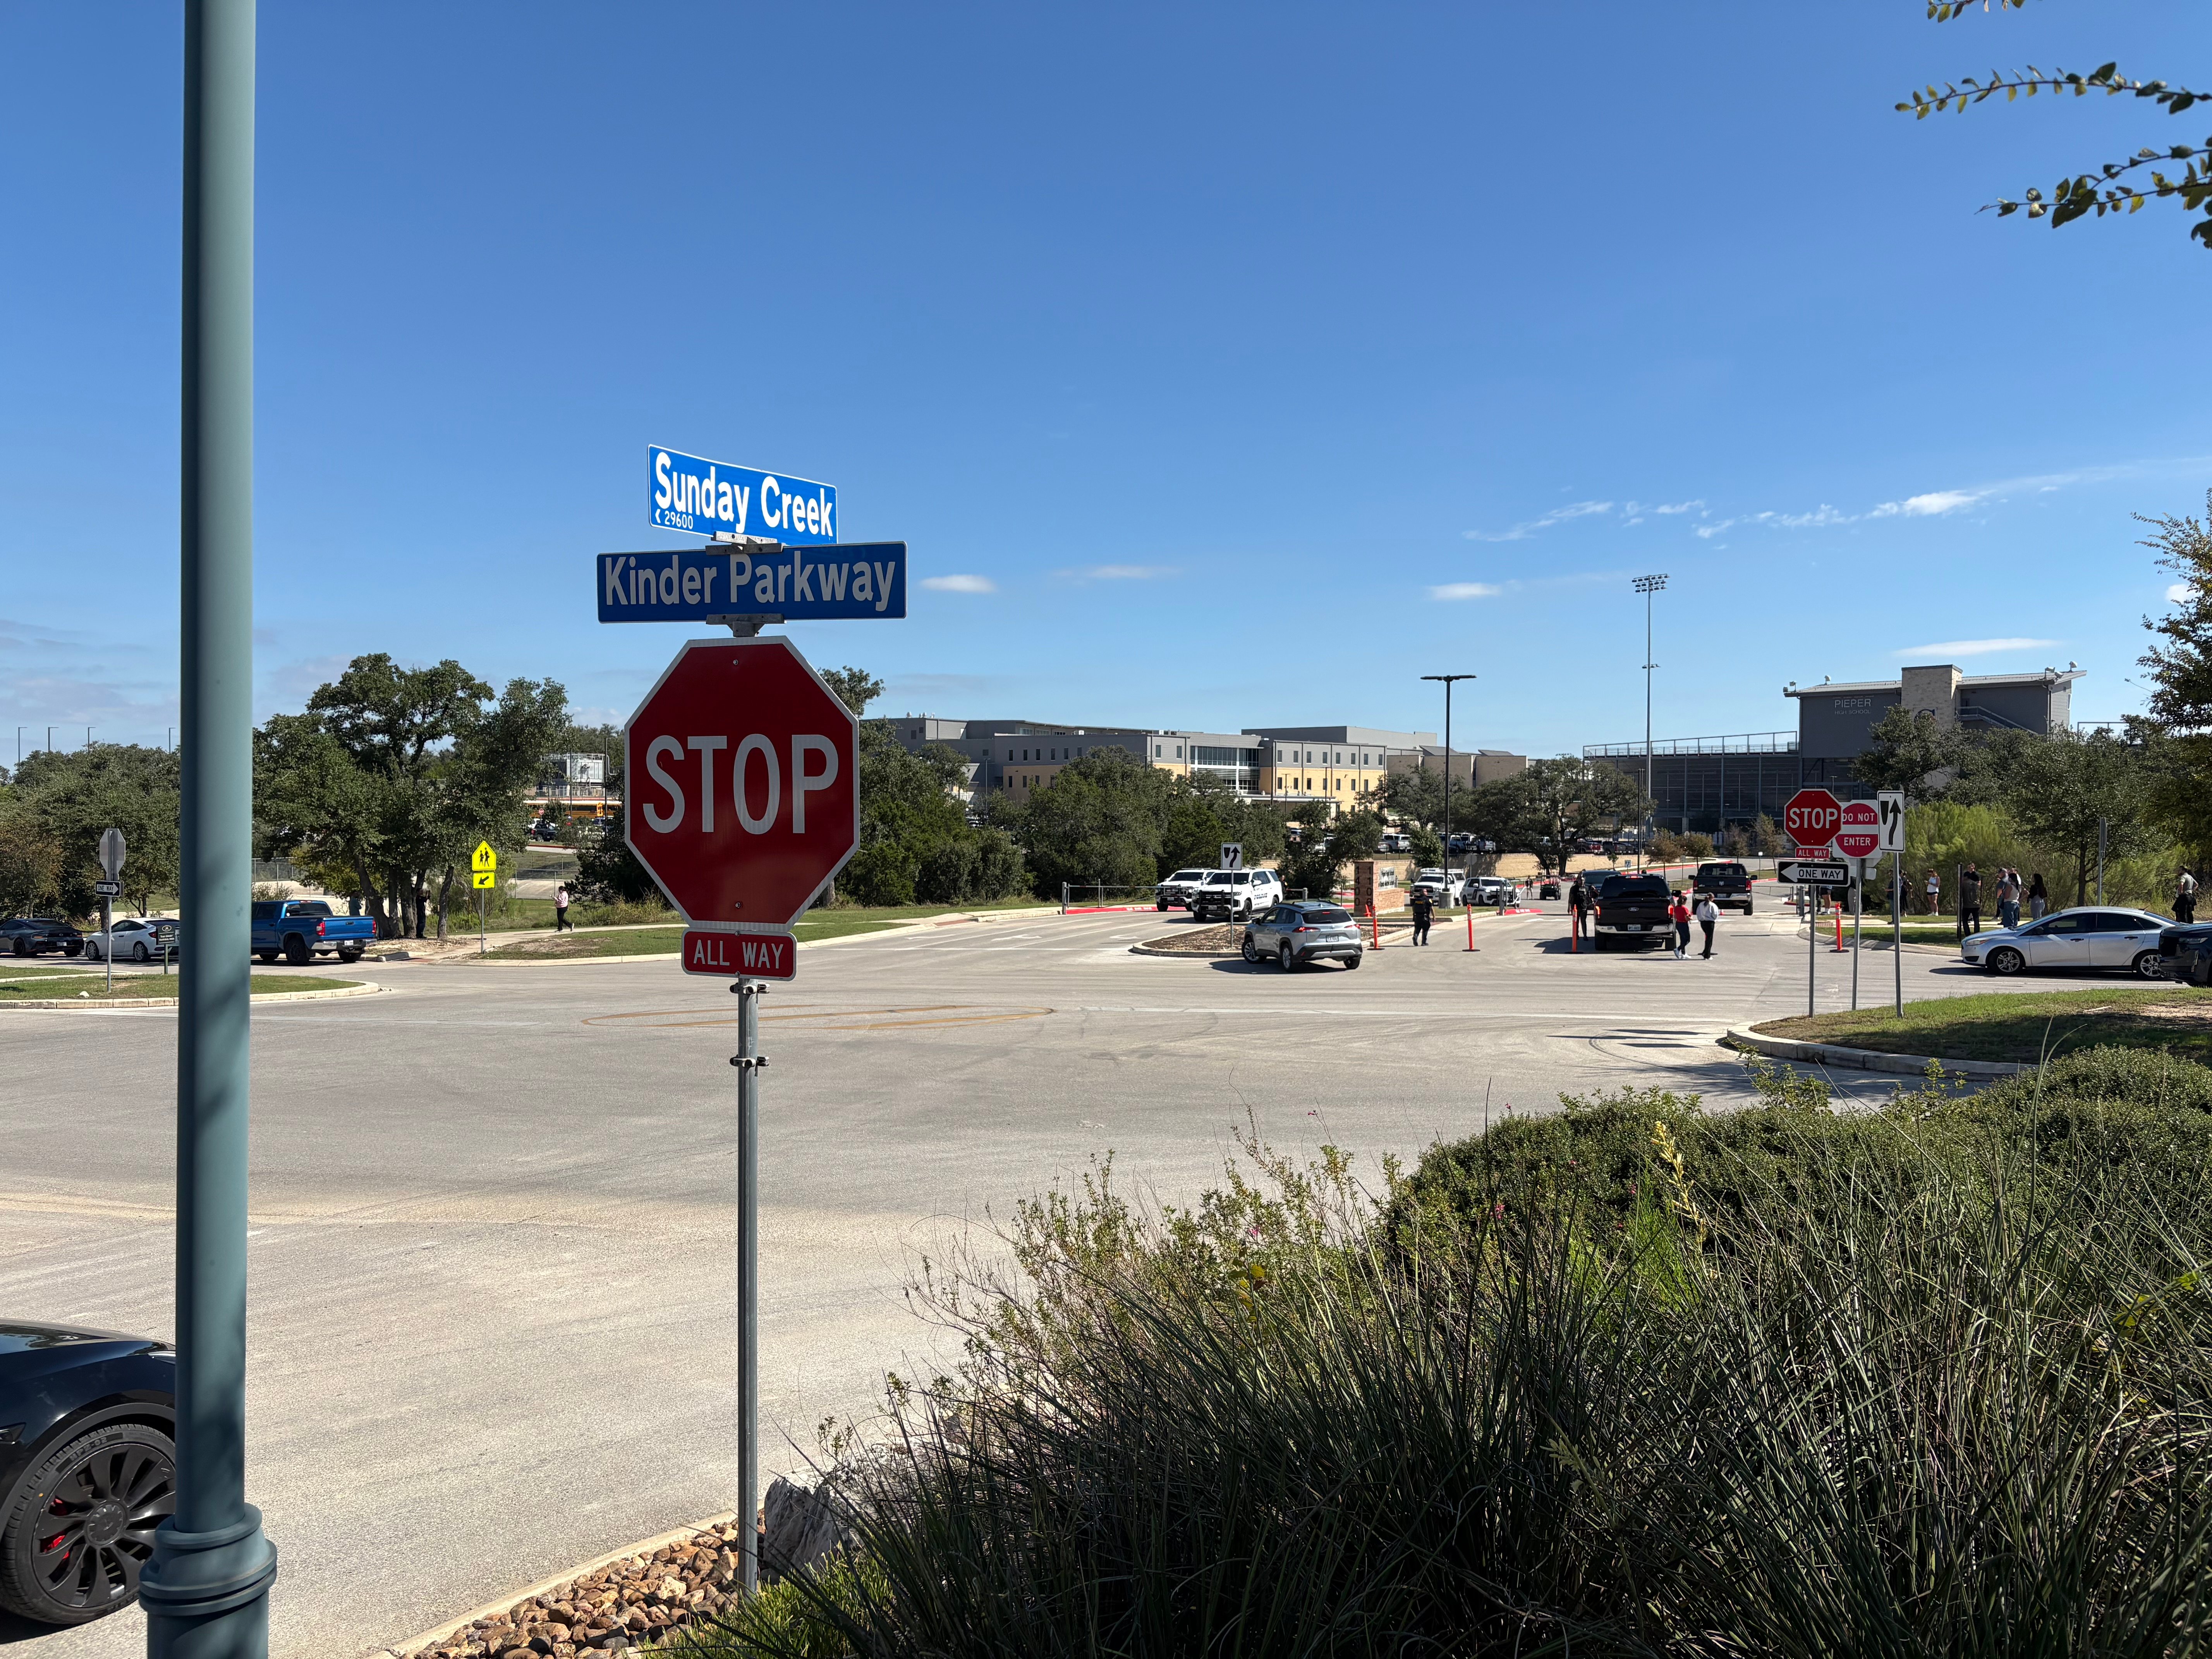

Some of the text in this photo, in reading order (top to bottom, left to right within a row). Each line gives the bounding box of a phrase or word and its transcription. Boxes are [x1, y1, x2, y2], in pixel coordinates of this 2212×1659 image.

[654, 452, 833, 537] Sunday Creek
[665, 510, 693, 530] 29600
[605, 551, 896, 611] Kinder Parkway
[1834, 699, 1871, 708] PIEPER
[642, 733, 839, 835] STOP
[1788, 807, 1838, 829] STOP
[1842, 813, 1875, 821] DO NOT
[1844, 837, 1871, 846] ENTER
[1798, 869, 1841, 879] ONE WAY
[694, 939, 784, 969] ALL WAY
